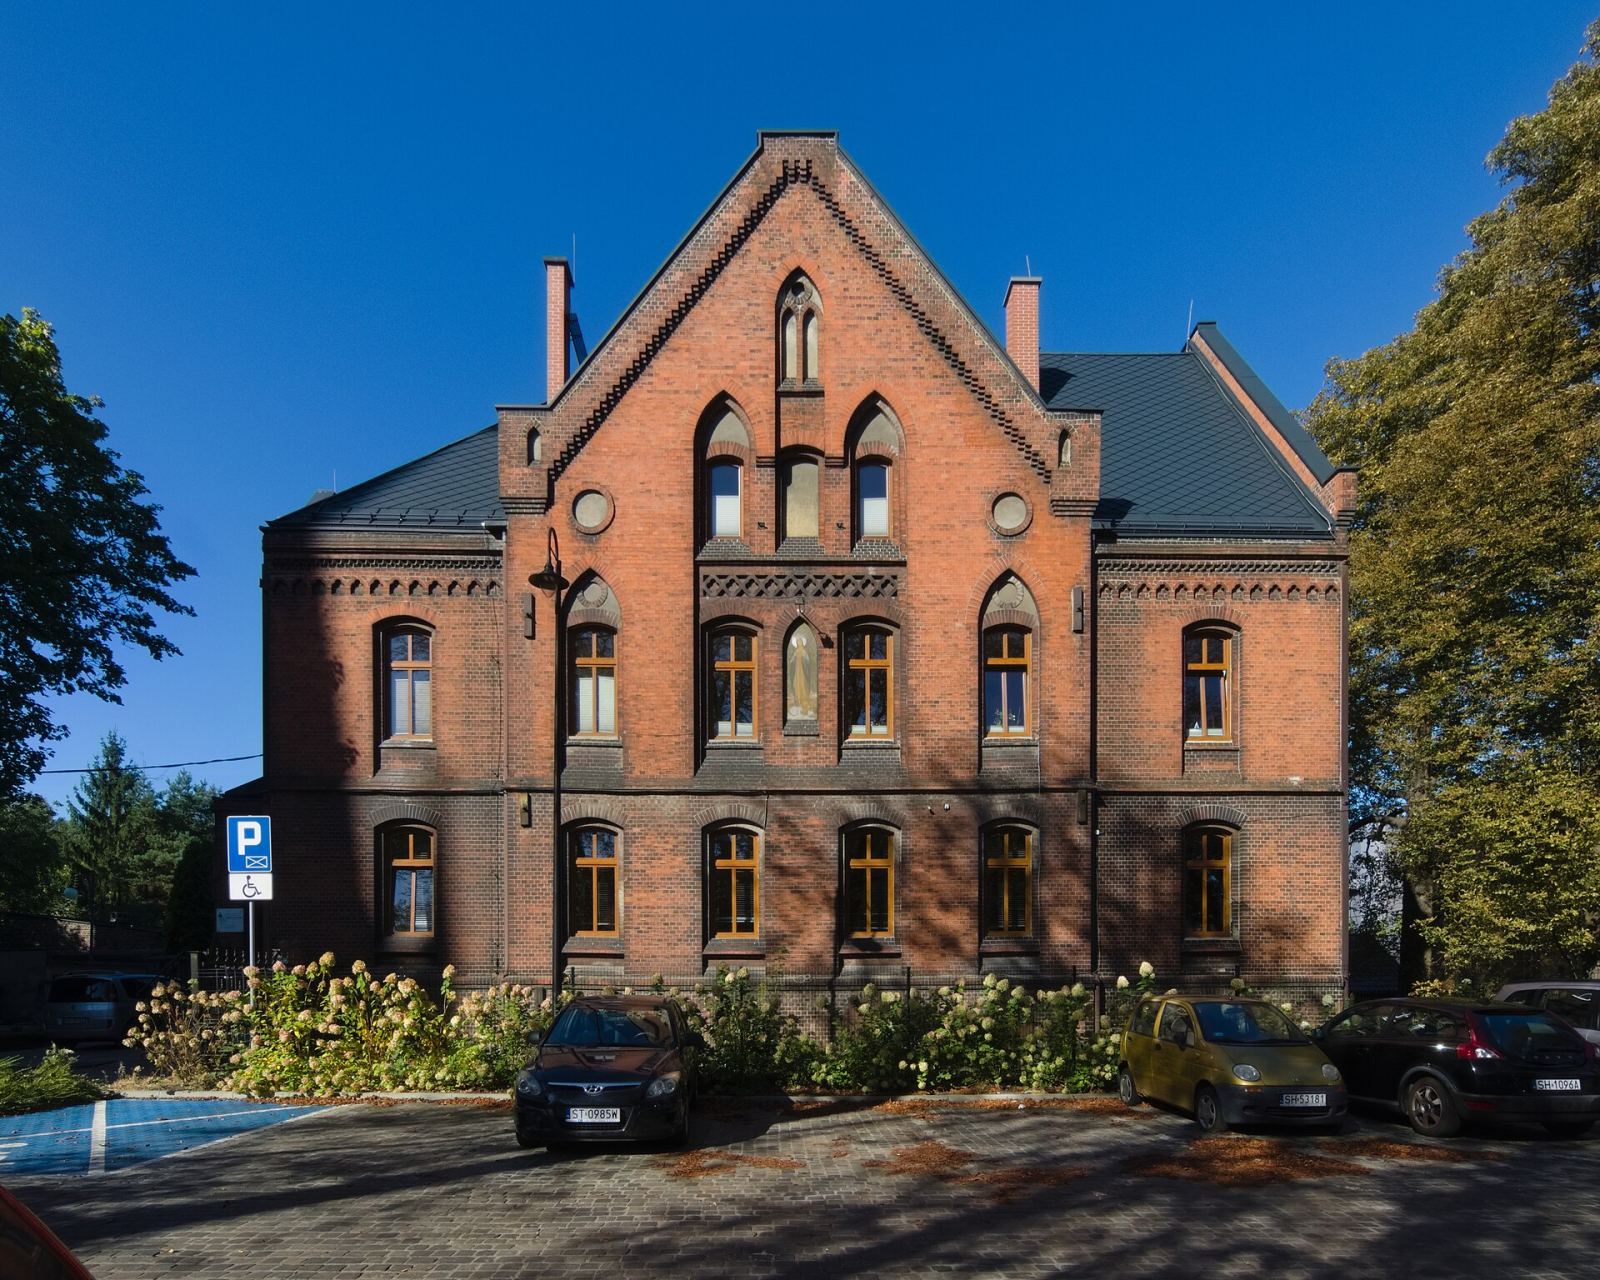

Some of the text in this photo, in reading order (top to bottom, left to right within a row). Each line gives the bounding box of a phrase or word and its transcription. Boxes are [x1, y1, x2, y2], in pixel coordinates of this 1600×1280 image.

[238, 821, 262, 856] P
[1537, 1080, 1551, 1090] SH
[1284, 1094, 1325, 1105] SH 53181
[572, 1109, 618, 1120] ST 0985W
